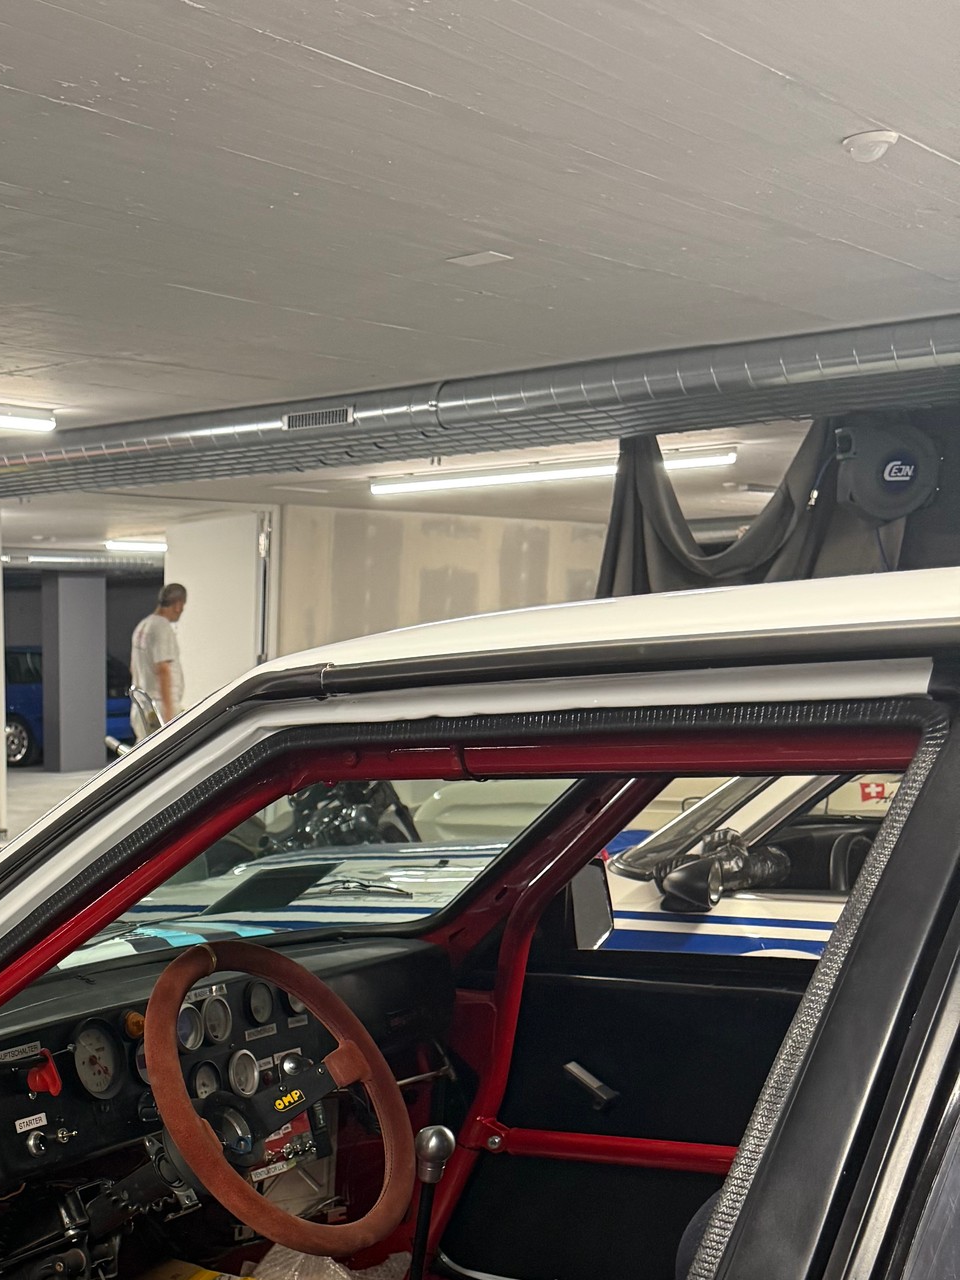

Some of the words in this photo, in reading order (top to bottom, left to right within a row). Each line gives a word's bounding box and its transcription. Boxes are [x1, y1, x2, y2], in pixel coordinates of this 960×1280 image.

[884, 461, 914, 481] CEJN
[275, 1089, 300, 1110] OMP
[18, 1116, 43, 1131] STARTER
